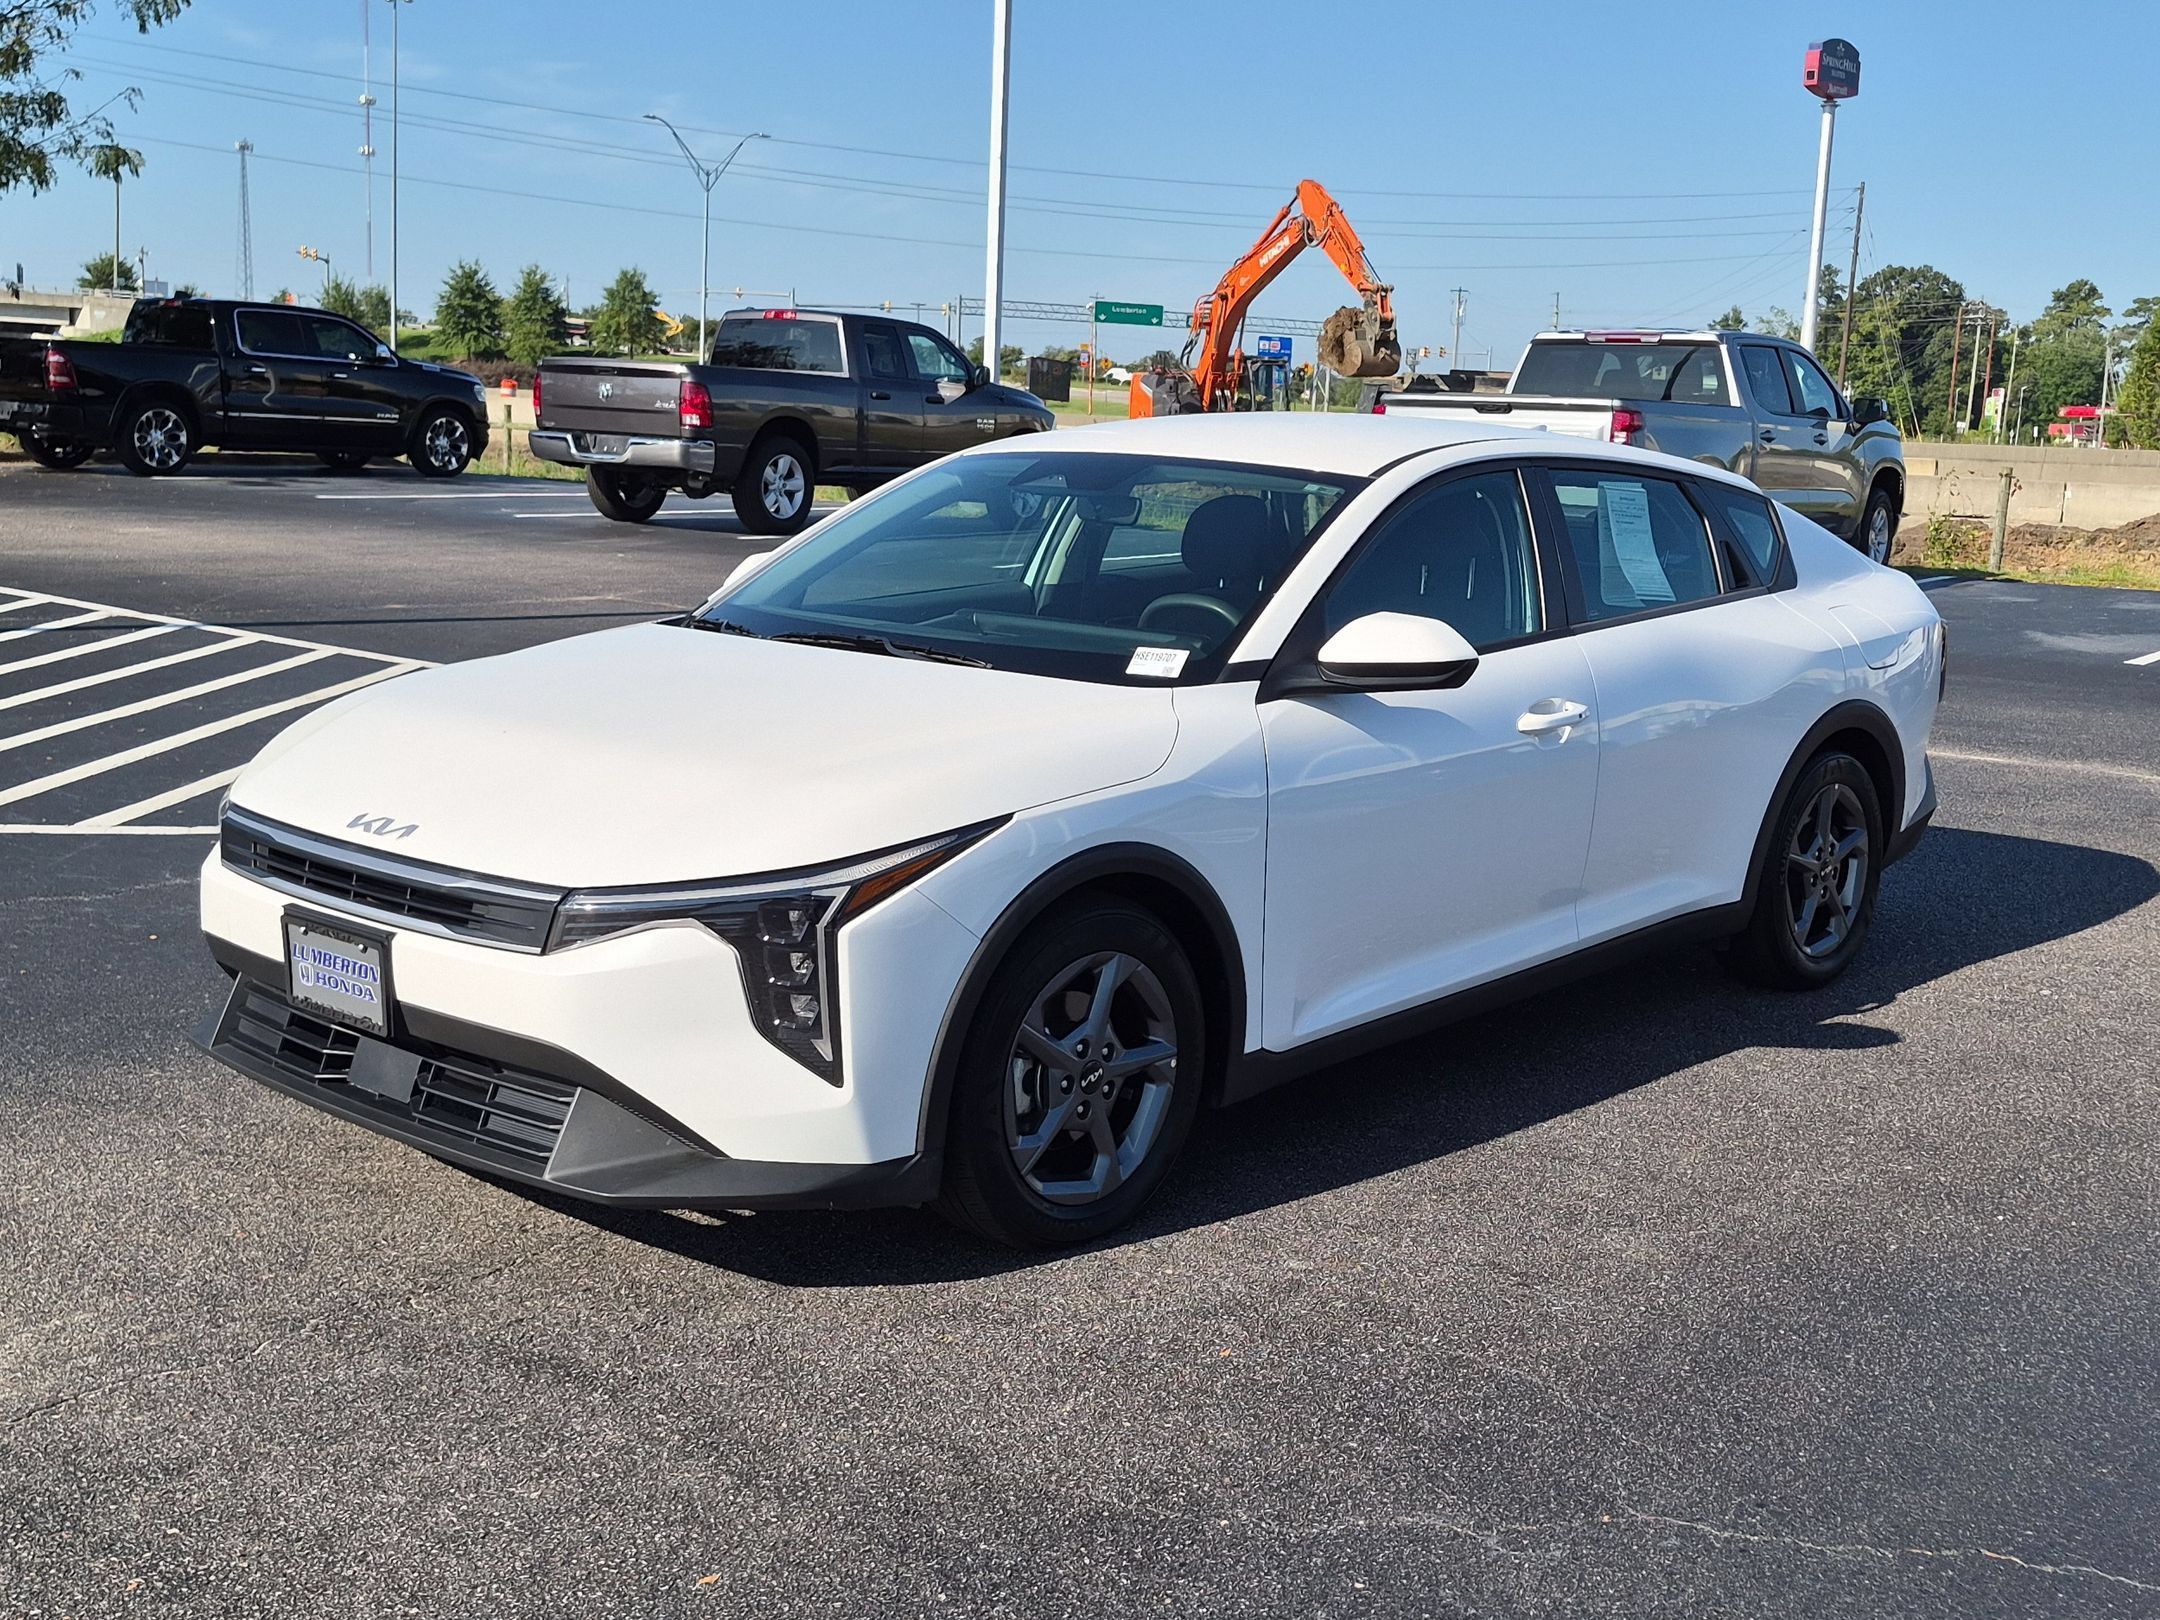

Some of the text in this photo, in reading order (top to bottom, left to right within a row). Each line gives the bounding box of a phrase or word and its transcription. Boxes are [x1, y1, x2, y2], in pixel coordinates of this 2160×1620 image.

[1259, 235, 1290, 268] HITACHI
[1111, 305, 1147, 314] Lumberton
[292, 943, 380, 984] LUMBERTON
[315, 971, 377, 1003] HONDA
